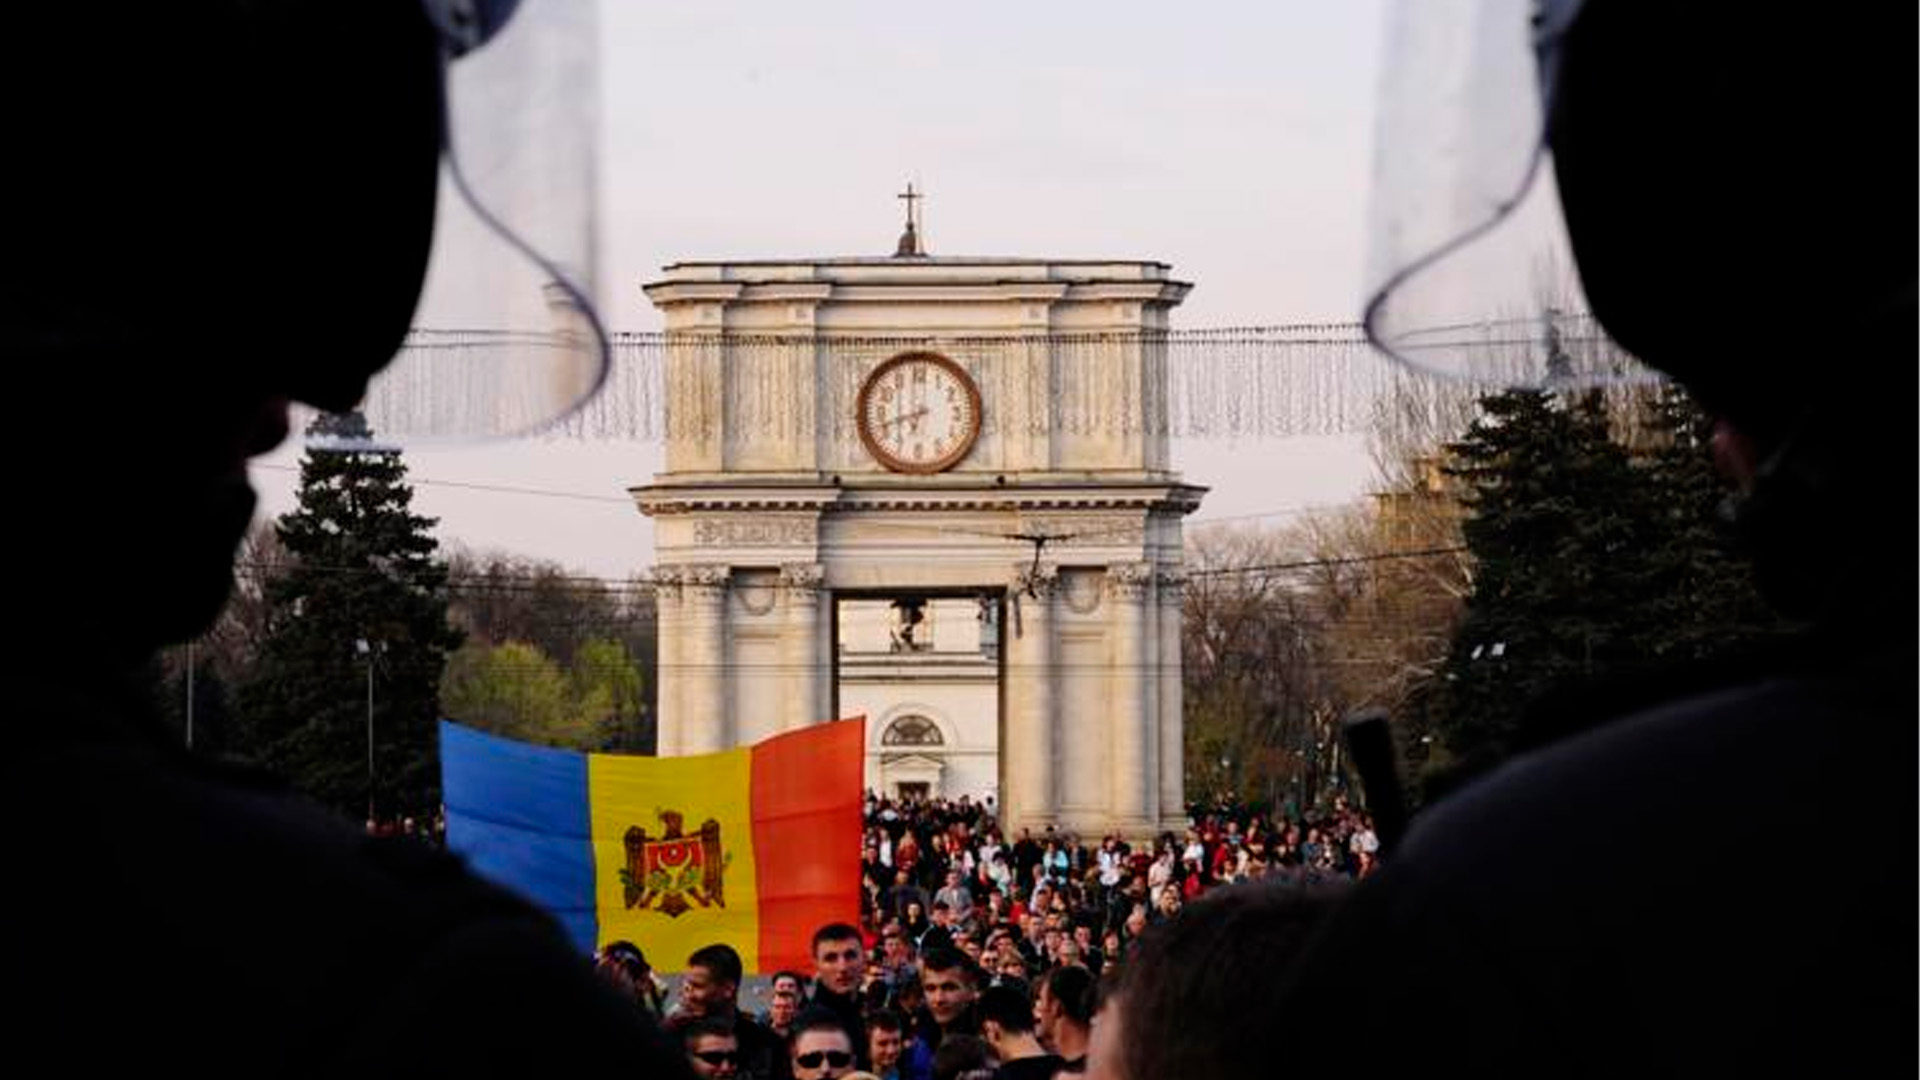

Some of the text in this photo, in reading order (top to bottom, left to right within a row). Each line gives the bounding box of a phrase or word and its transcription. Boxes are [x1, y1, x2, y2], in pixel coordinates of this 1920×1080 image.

[912, 366, 926, 384] 12
[945, 386, 955, 403] 2
[953, 405, 962, 422] 3
